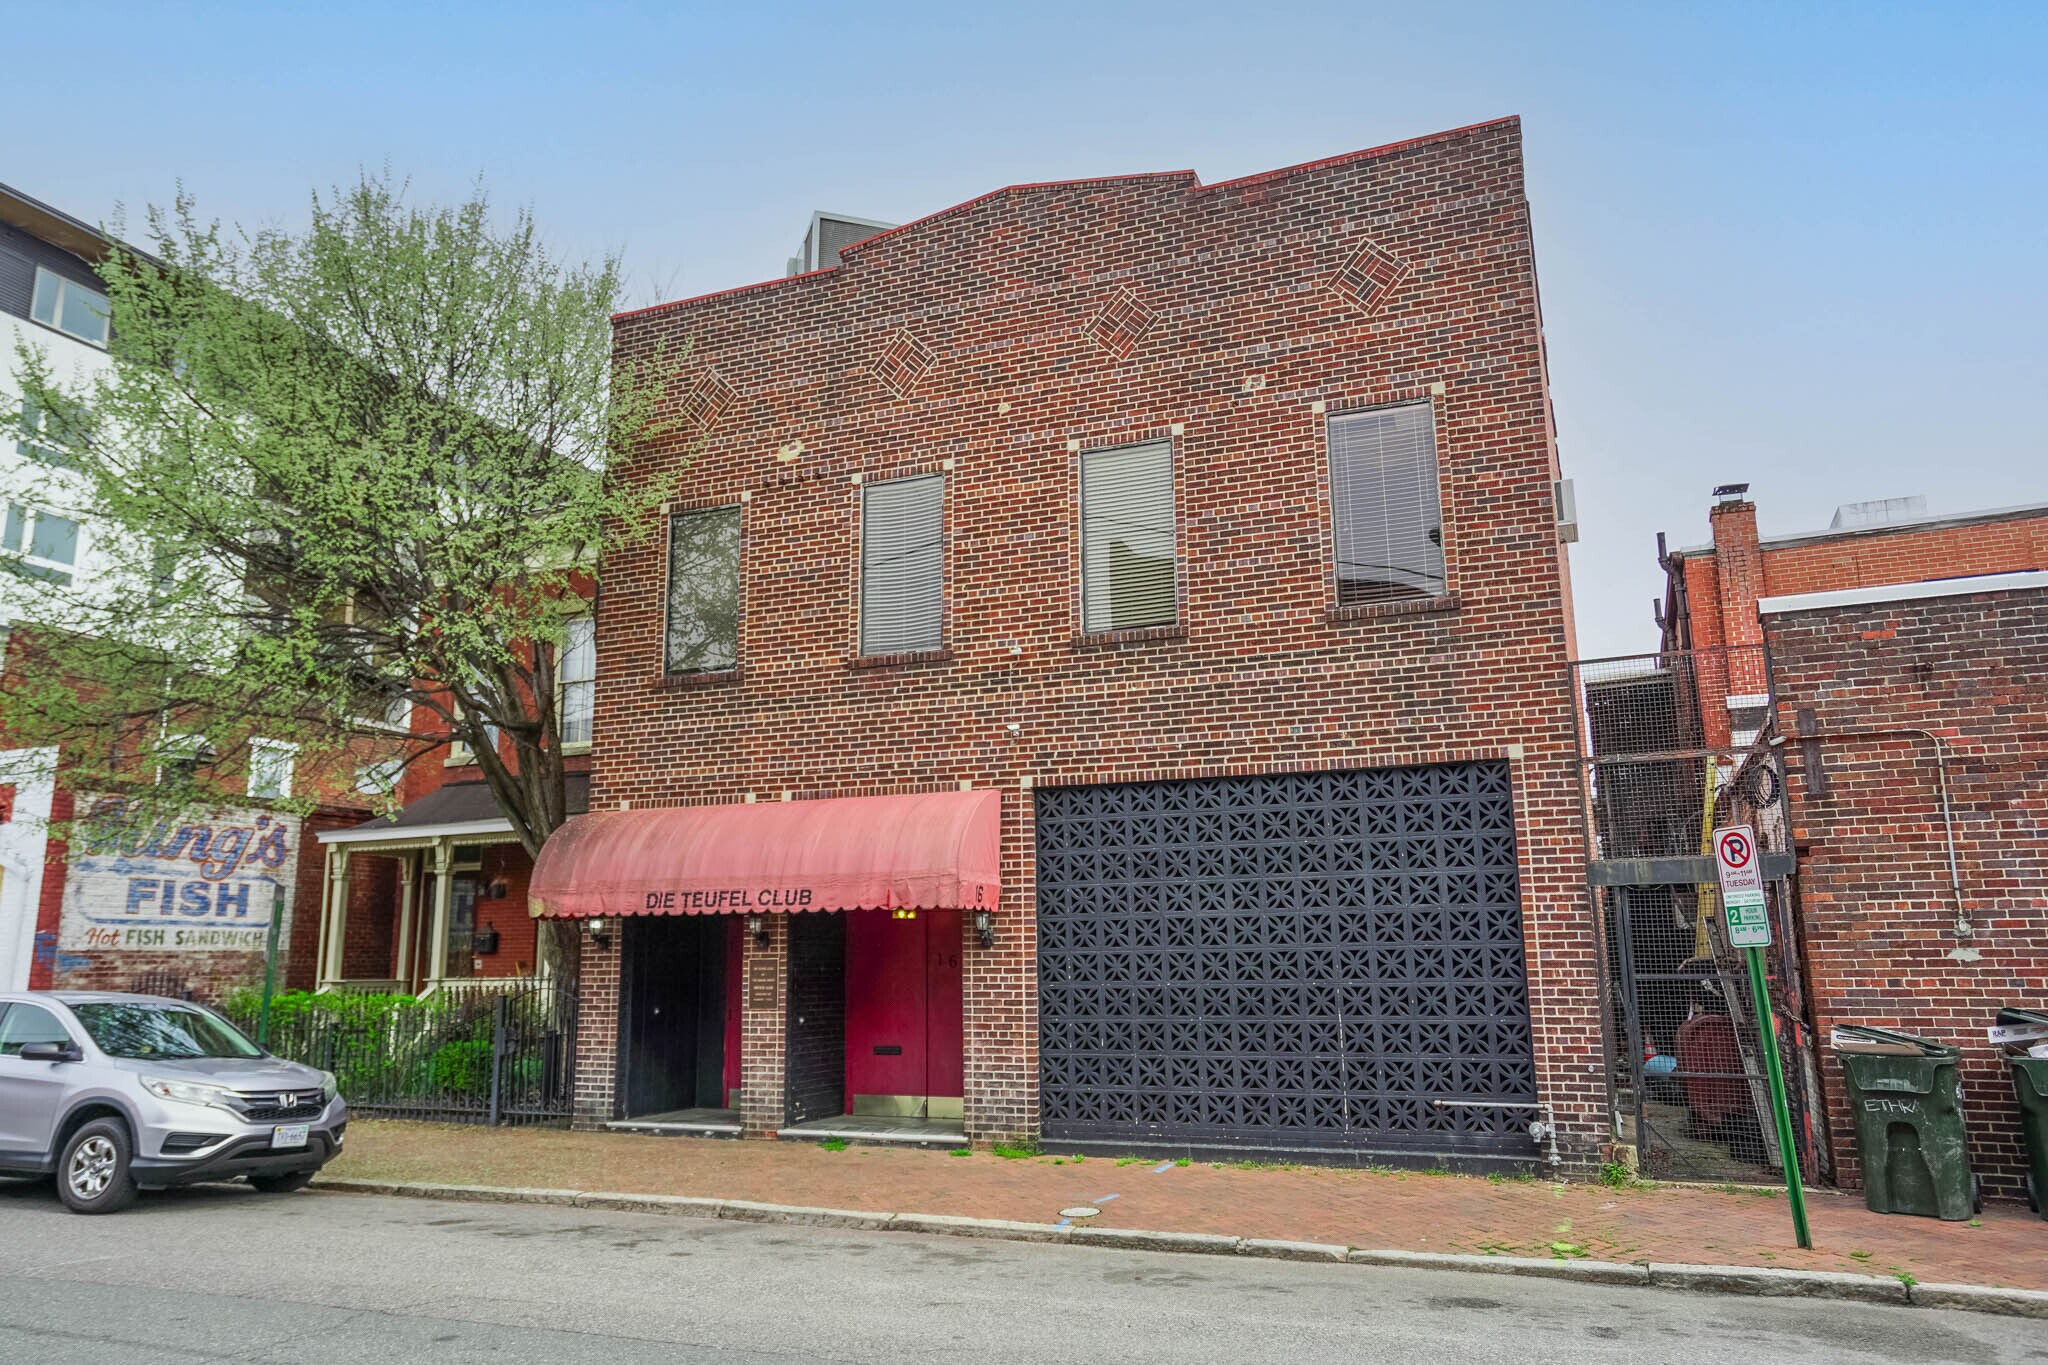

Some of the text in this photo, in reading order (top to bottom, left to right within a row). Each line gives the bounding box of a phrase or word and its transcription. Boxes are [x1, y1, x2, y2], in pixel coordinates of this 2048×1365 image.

[1725, 878, 1755, 888] TUESDAY
[125, 877, 250, 917] FISH
[646, 889, 812, 909] DIE TEUFEL CLUB
[1730, 909, 1740, 923] 2
[85, 927, 264, 947] Hot FISH SANDWICH
[938, 953, 958, 968] 16
